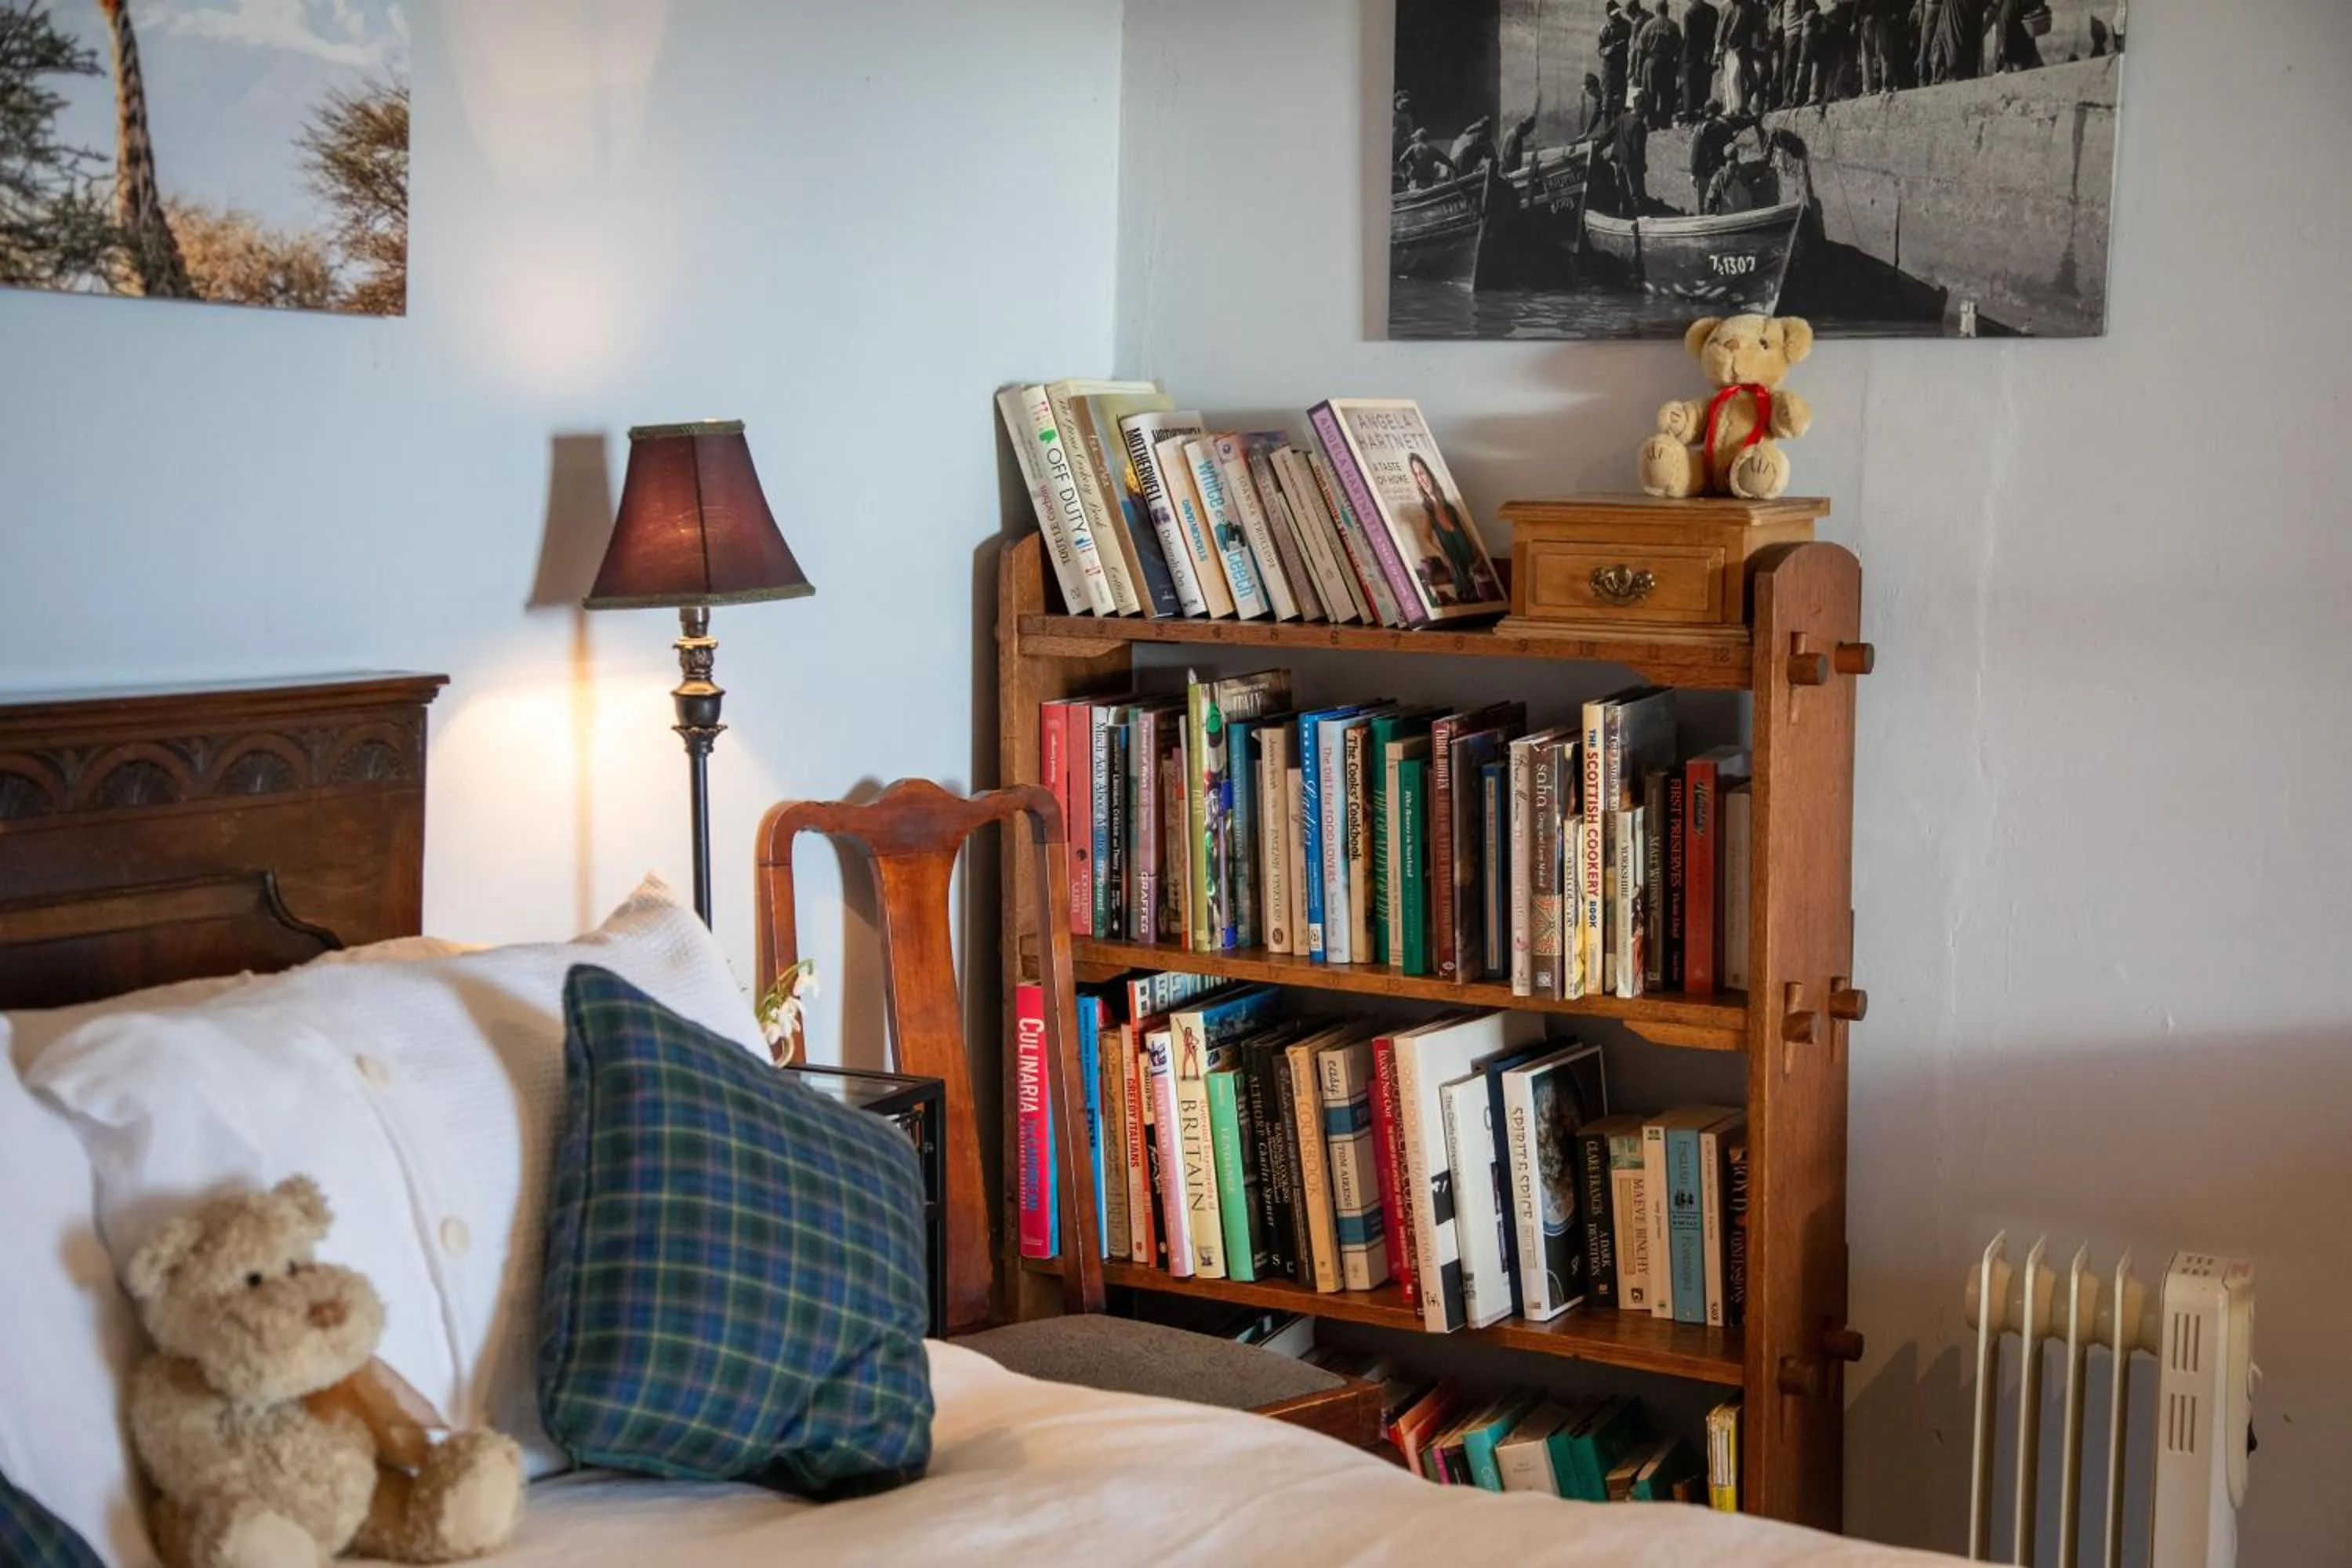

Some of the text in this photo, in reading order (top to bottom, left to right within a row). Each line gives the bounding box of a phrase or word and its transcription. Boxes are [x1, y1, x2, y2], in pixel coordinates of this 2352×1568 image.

[1356, 434, 1428, 450] HARTNETT
[1357, 413, 1411, 430] ANGELA
[1124, 426, 1163, 506] MOTHERWELL
[1316, 415, 1348, 467] ANGELA
[1341, 467, 1378, 535] HARTNETT
[1377, 474, 1410, 485] OF HOME
[1379, 462, 1403, 471] TASTE
[1045, 445, 1087, 536] OFF DUTY
[1196, 458, 1227, 509] white
[1226, 550, 1257, 597] teeth
[1094, 721, 1106, 752] Much
[1322, 746, 1332, 765] The
[1346, 736, 1357, 760] The
[1588, 728, 1596, 748] THE
[1094, 757, 1106, 779] Ado
[1323, 767, 1333, 790] DIET
[1535, 761, 1552, 807] saha
[1585, 750, 1599, 824] SCOTTISH
[1301, 780, 1318, 847] Ladies
[1323, 792, 1333, 806] for
[1670, 778, 1682, 814] FIRST
[1324, 809, 1334, 840] FOOD
[1348, 802, 1361, 861] Cookbook
[1325, 842, 1336, 883] LOVERS
[1586, 828, 1599, 896] COOKERY
[1620, 846, 1629, 898] YORKSHIRE
[1669, 818, 1682, 887] PRESERVES
[1018, 1018, 1046, 1112] CULINARIA
[1126, 1078, 1137, 1119] GREEDY
[1127, 1122, 1139, 1167] ITALIANS
[1179, 1099, 1206, 1210] BRITAIN
[1248, 1075, 1275, 1226] ALTHORP Charles Spencer
[1295, 1100, 1323, 1200] COOKBOOK
[1409, 1140, 1420, 1156] BY
[1509, 1106, 1527, 1160] SPIRIT
[1585, 1141, 1600, 1169] CLARE
[1336, 1145, 1348, 1169] TOM
[1395, 1123, 1414, 1235] CHOCOLATE
[1411, 1160, 1426, 1211] MARTIN
[1515, 1174, 1533, 1219] SPICE
[1417, 1214, 1432, 1269] WISHART
[1632, 1178, 1648, 1275] MAEVE BINCHY
